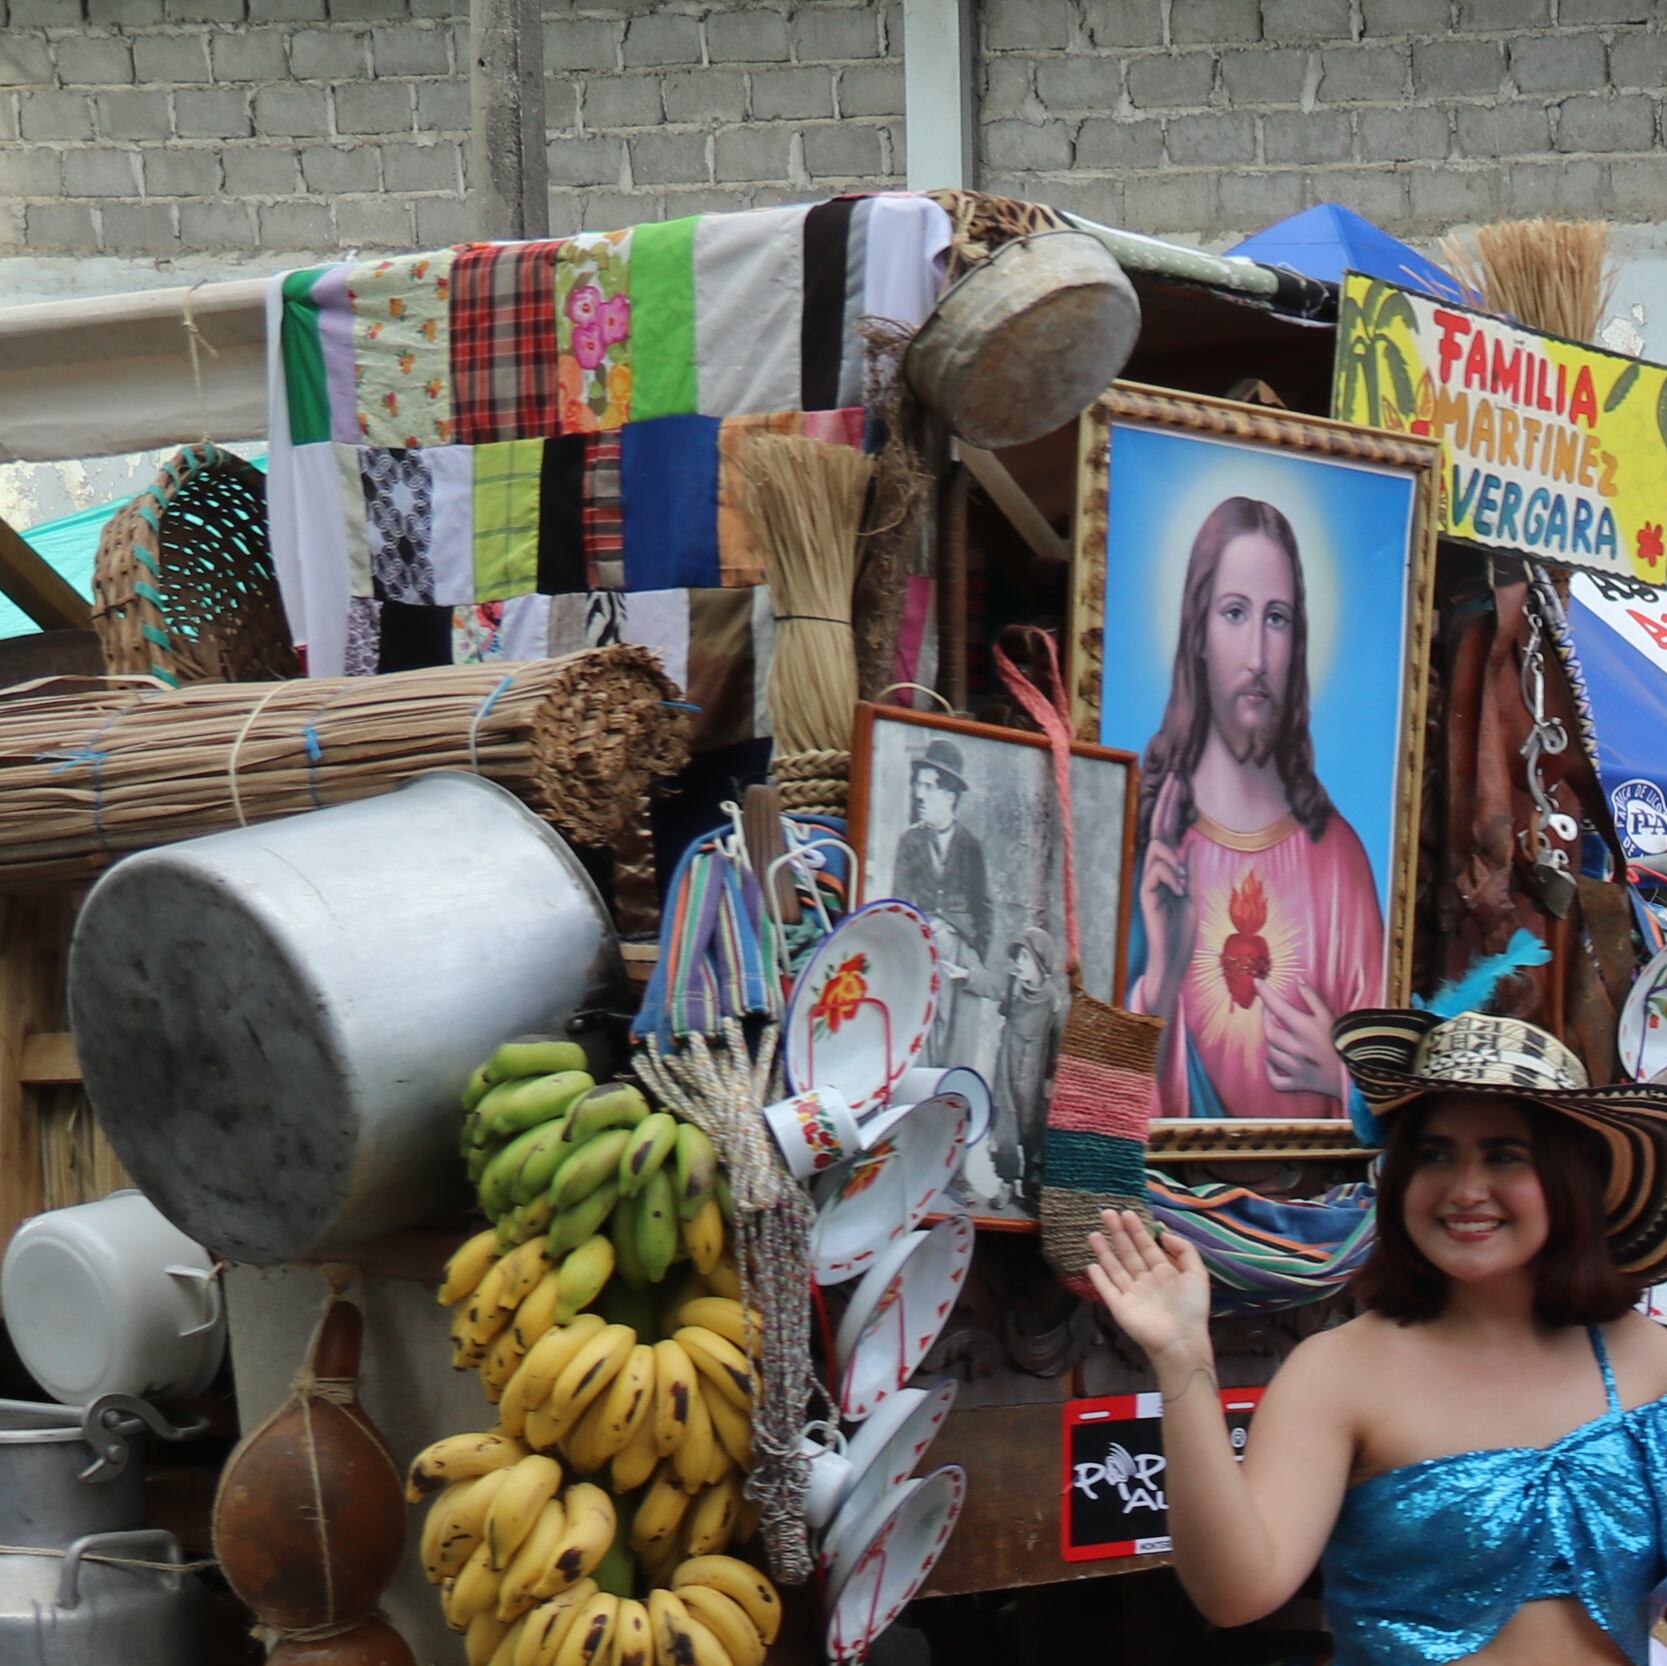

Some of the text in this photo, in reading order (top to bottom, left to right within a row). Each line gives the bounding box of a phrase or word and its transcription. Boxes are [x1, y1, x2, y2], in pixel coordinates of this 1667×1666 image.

[1433, 308, 1597, 430] FAMILIA
[1432, 384, 1619, 498] MARTINEZ
[1451, 463, 1618, 560] VERGARA
